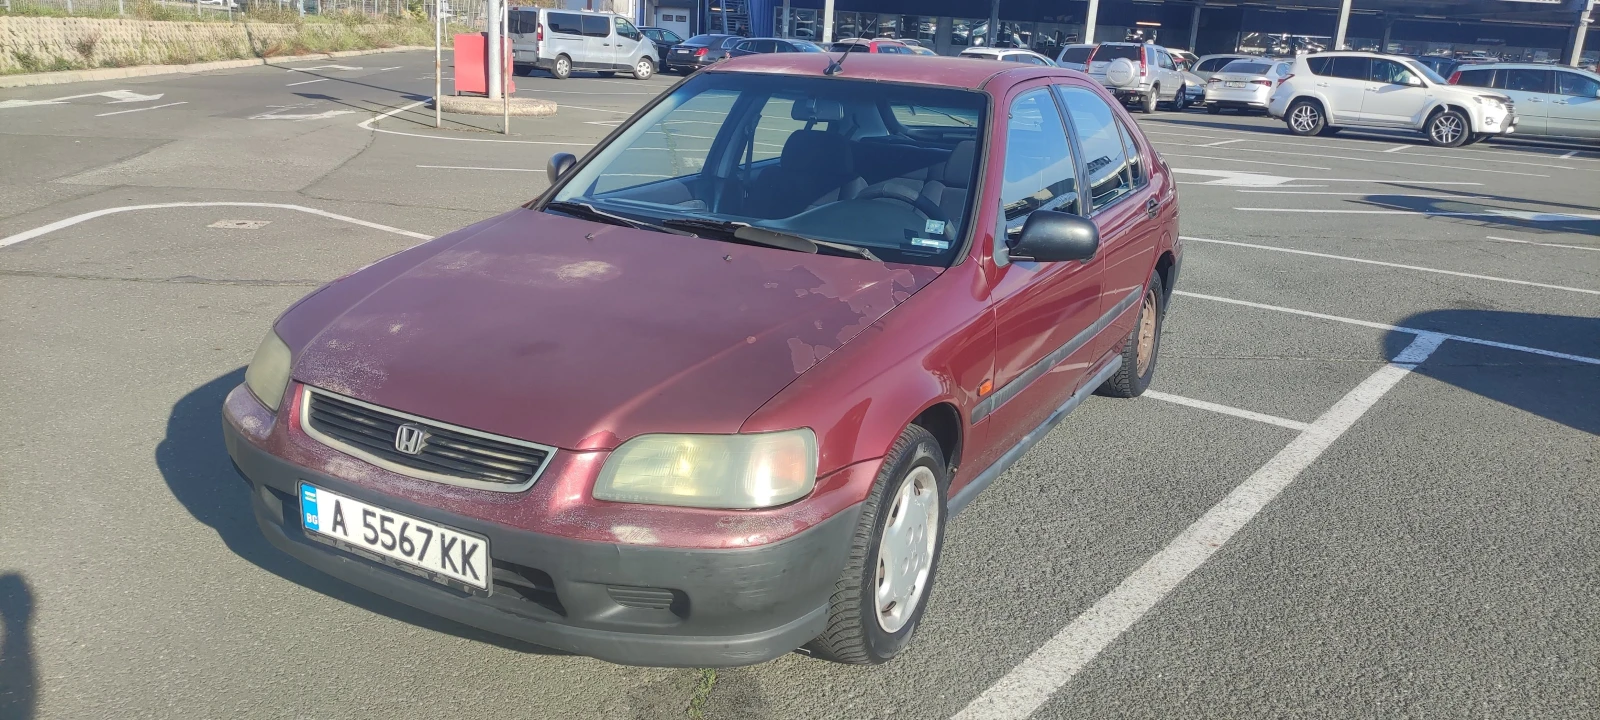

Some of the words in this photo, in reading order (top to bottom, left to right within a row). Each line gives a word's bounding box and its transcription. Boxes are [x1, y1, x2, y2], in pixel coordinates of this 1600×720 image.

[306, 512, 318, 526] BG
[331, 499, 348, 537] A
[362, 508, 433, 562] 5567
[440, 532, 480, 581] KK
